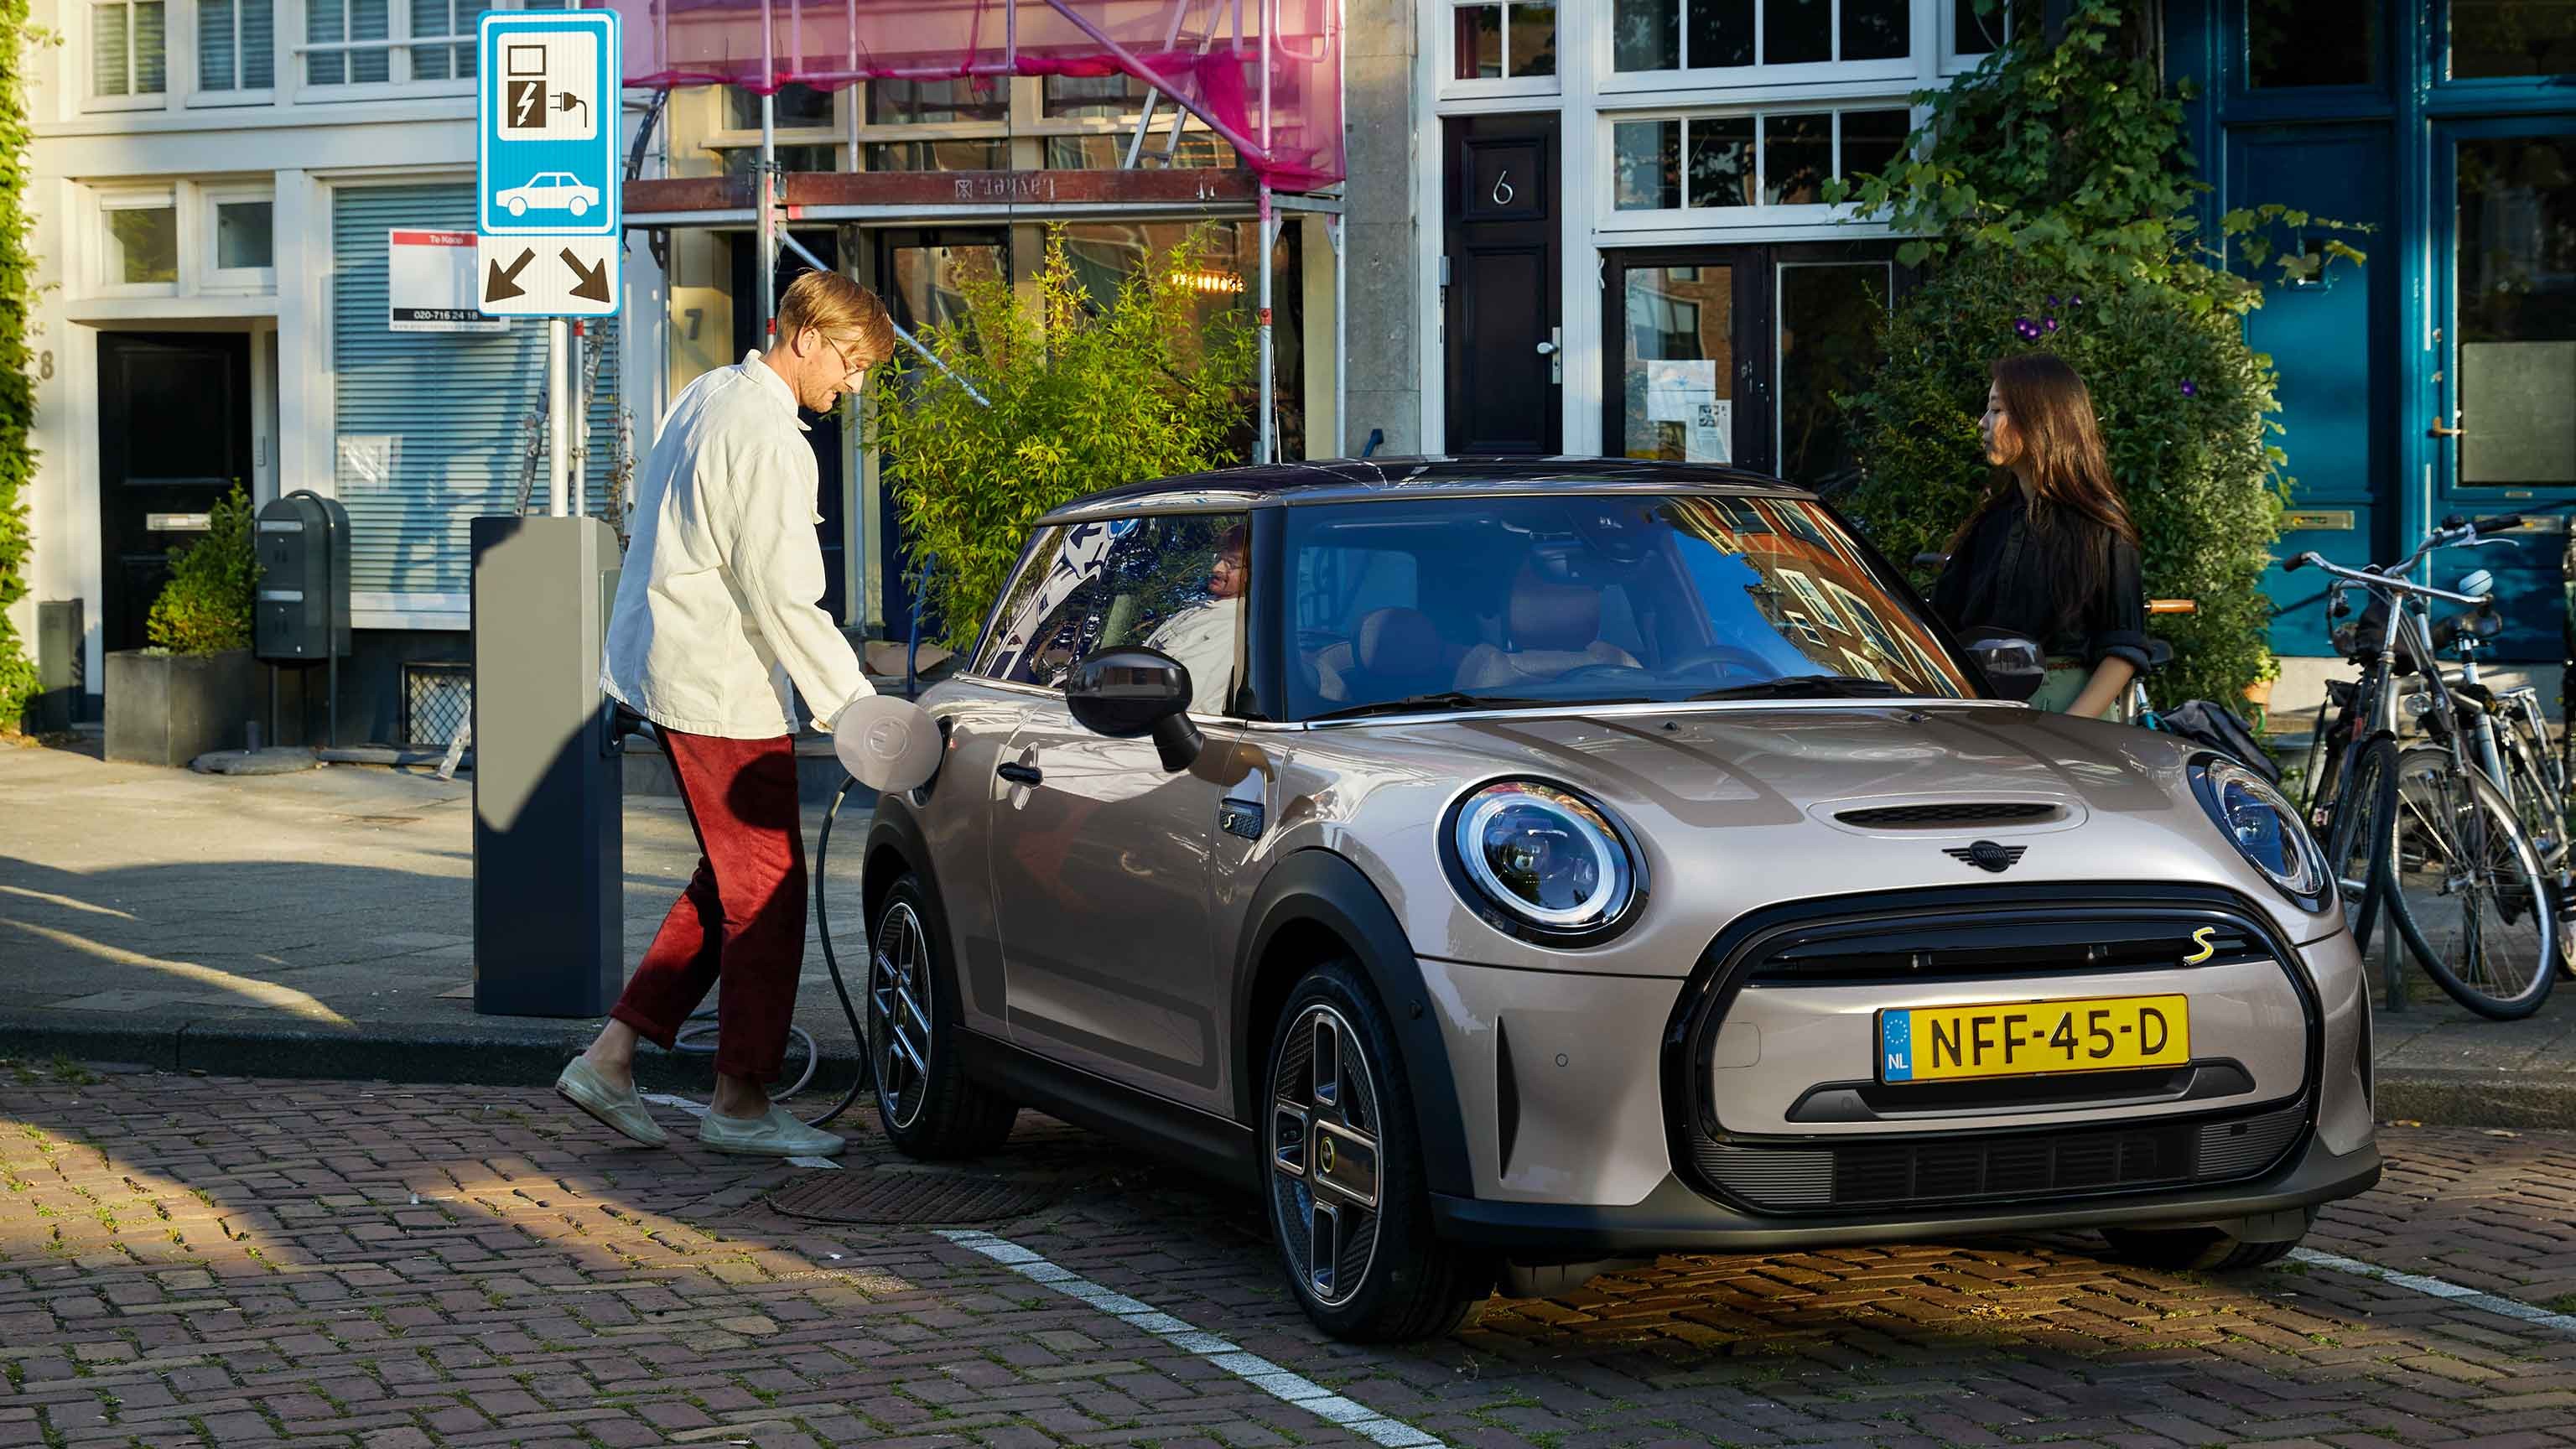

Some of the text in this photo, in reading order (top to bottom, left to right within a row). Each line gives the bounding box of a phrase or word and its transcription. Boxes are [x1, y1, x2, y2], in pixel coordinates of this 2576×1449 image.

[1493, 170, 1513, 205] 6
[428, 235, 440, 243] Te
[684, 309, 703, 340] 7
[41, 351, 54, 380] 8
[1978, 849, 2007, 860] MINI
[2183, 927, 2215, 965] S
[1888, 1007, 2168, 1070] NL NFF-45-D
